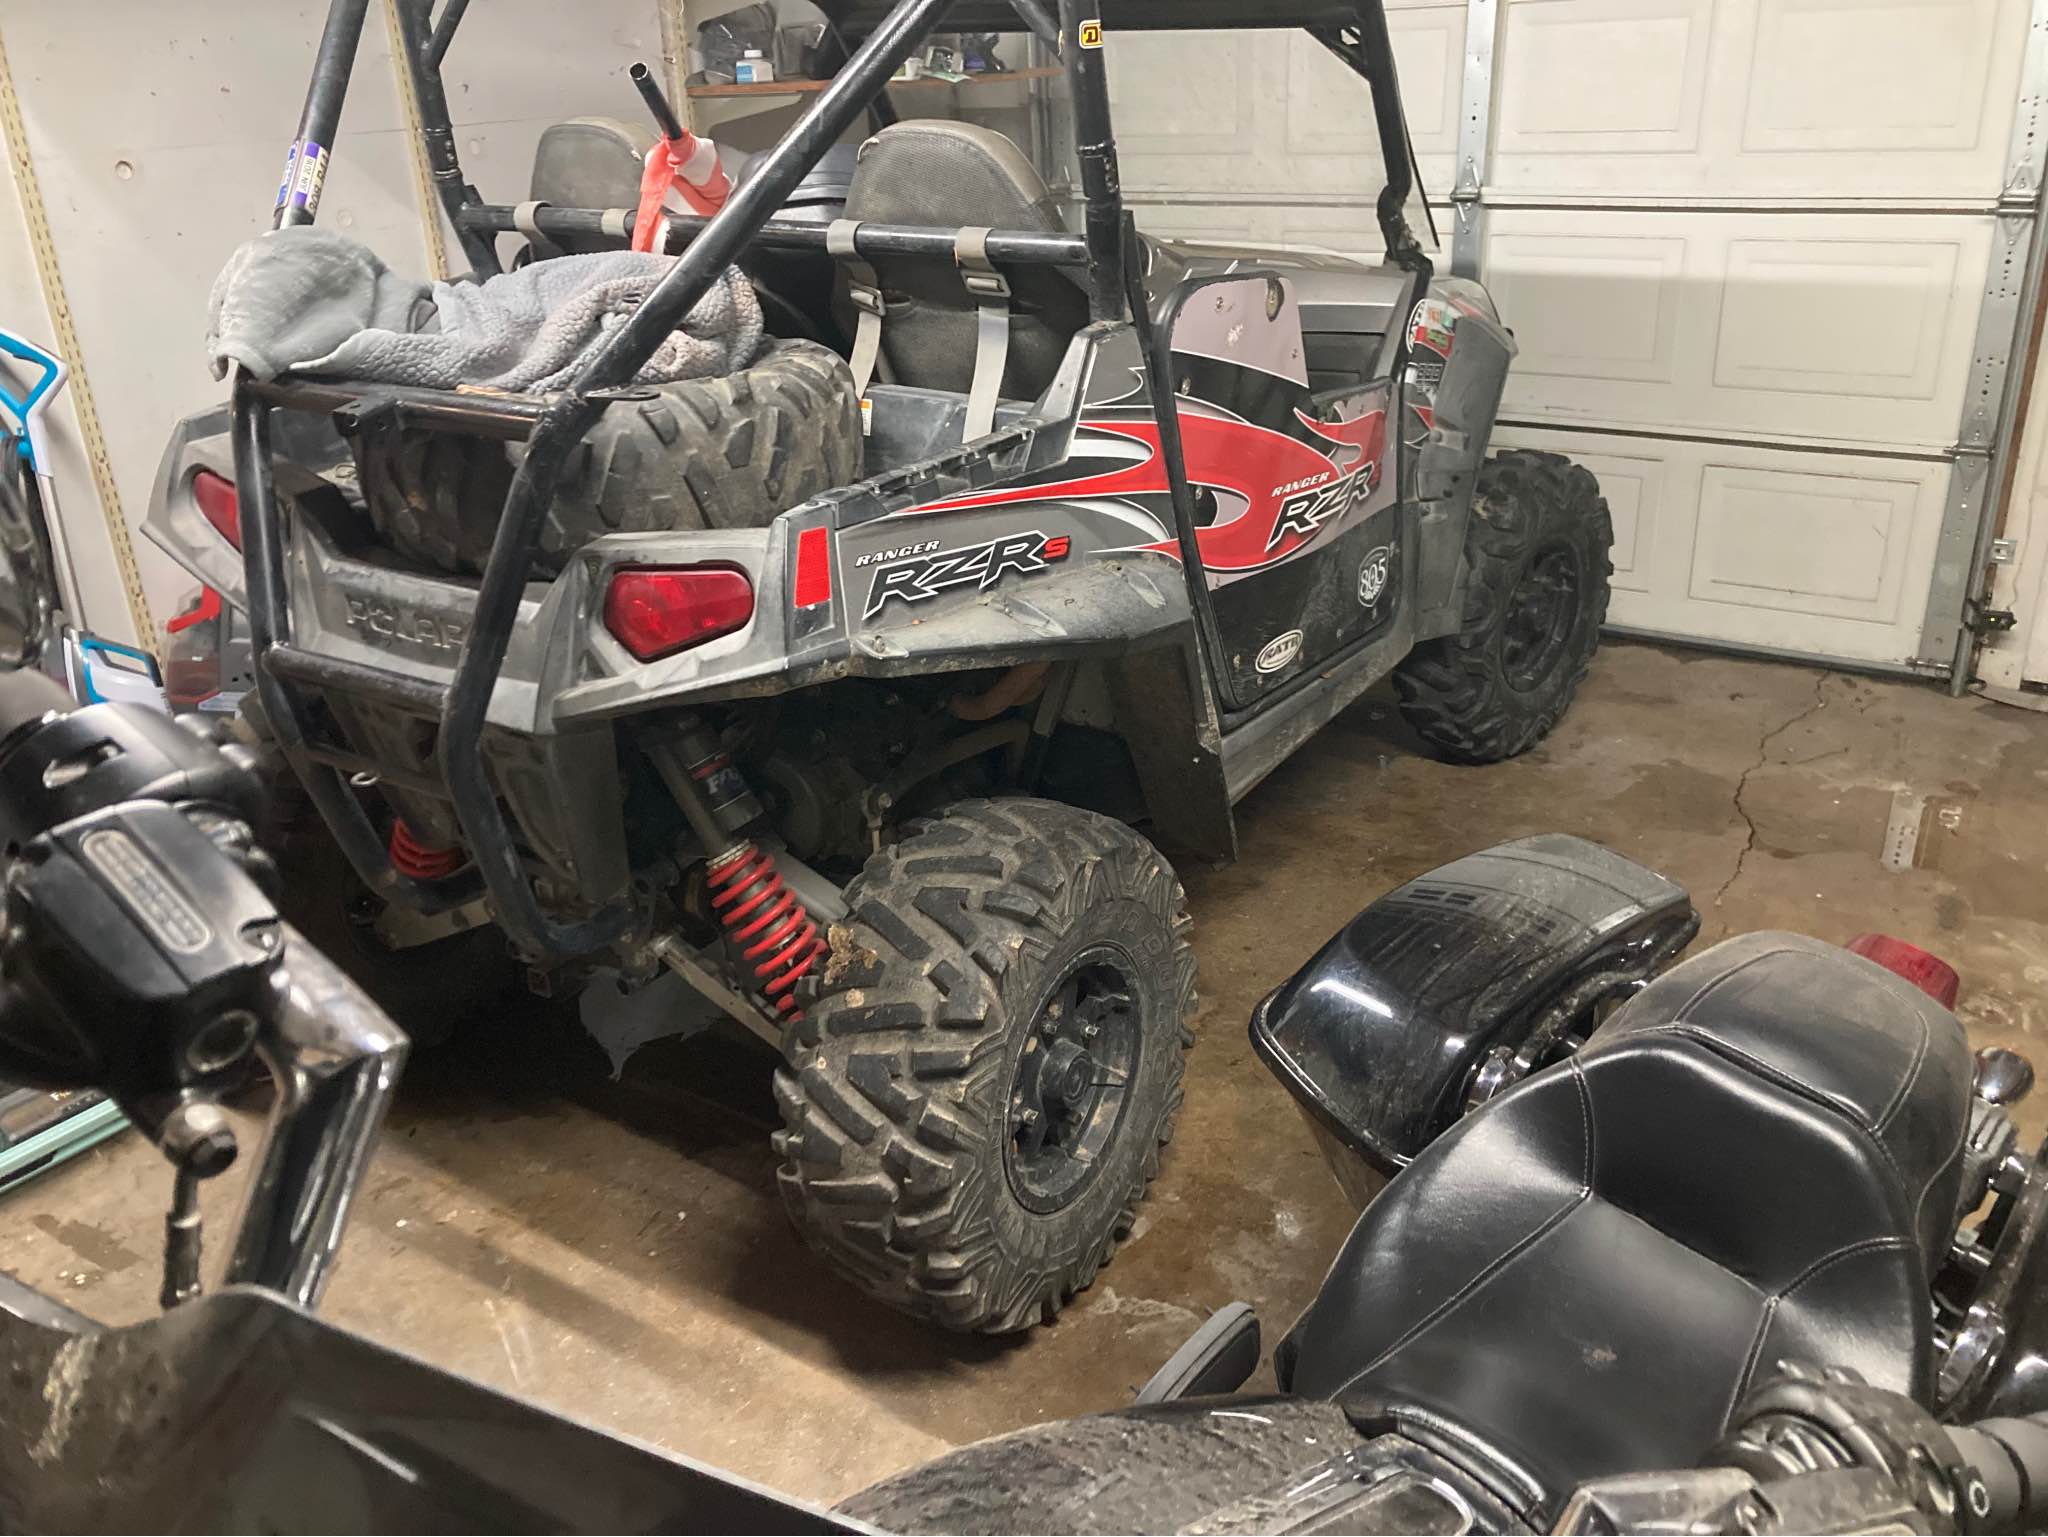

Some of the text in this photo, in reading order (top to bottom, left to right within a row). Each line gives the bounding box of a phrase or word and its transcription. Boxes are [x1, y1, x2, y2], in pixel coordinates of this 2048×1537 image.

[1271, 470, 1330, 498] RANGER
[1263, 460, 1375, 553] RZR
[855, 540, 941, 567] RANGER
[1361, 556, 1386, 597] 805
[346, 598, 468, 649] POLAR
